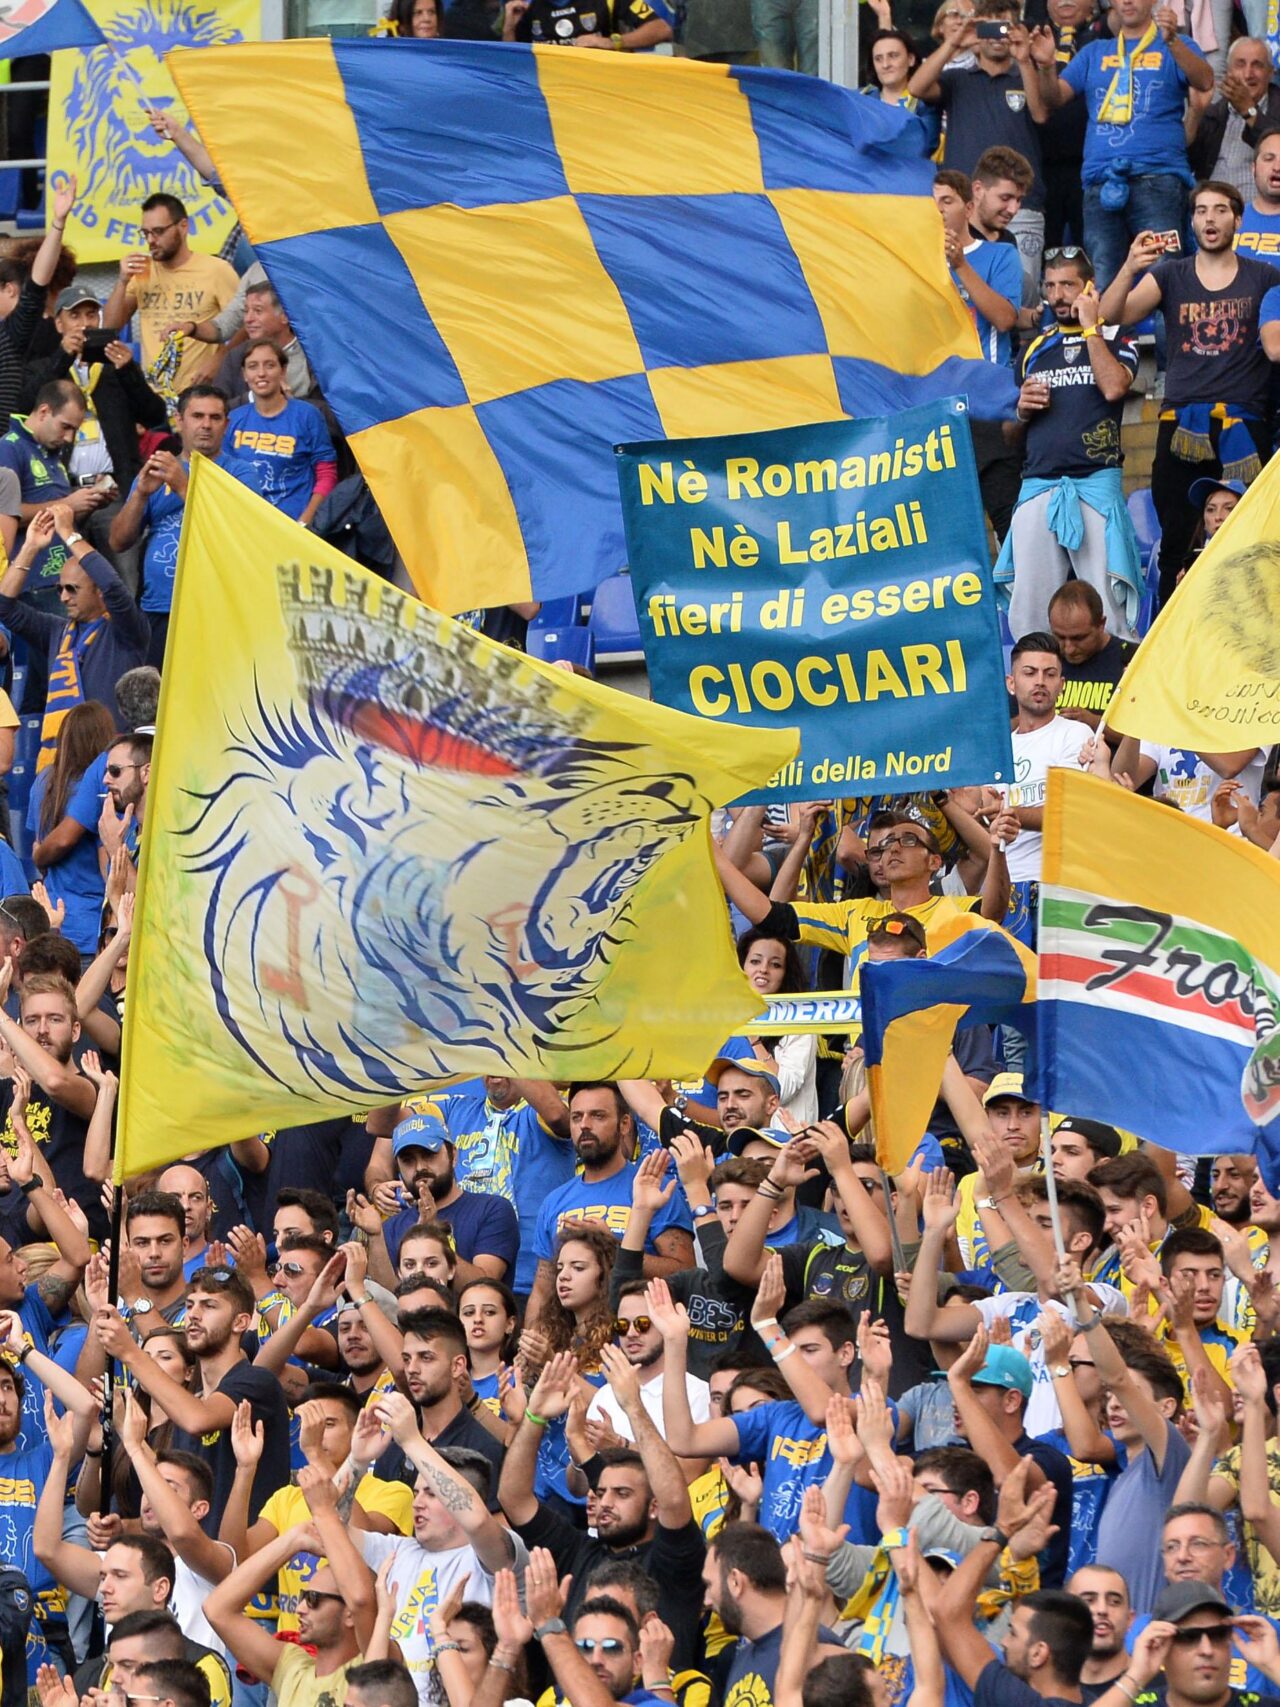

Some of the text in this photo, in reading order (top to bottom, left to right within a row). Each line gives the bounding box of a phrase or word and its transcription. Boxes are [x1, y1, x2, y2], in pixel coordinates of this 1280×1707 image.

[1232, 232, 1280, 251] 192
[234, 430, 296, 454] 1928
[639, 426, 956, 505] Nè Romanisti
[691, 501, 928, 569] Nè Laziali
[648, 572, 982, 637] fieri di essere
[689, 639, 967, 717] CIOCIARI
[1056, 680, 1113, 711] SINONE
[812, 757, 877, 784] della
[886, 746, 952, 776] Nord
[391, 1584, 432, 1641] URVA
